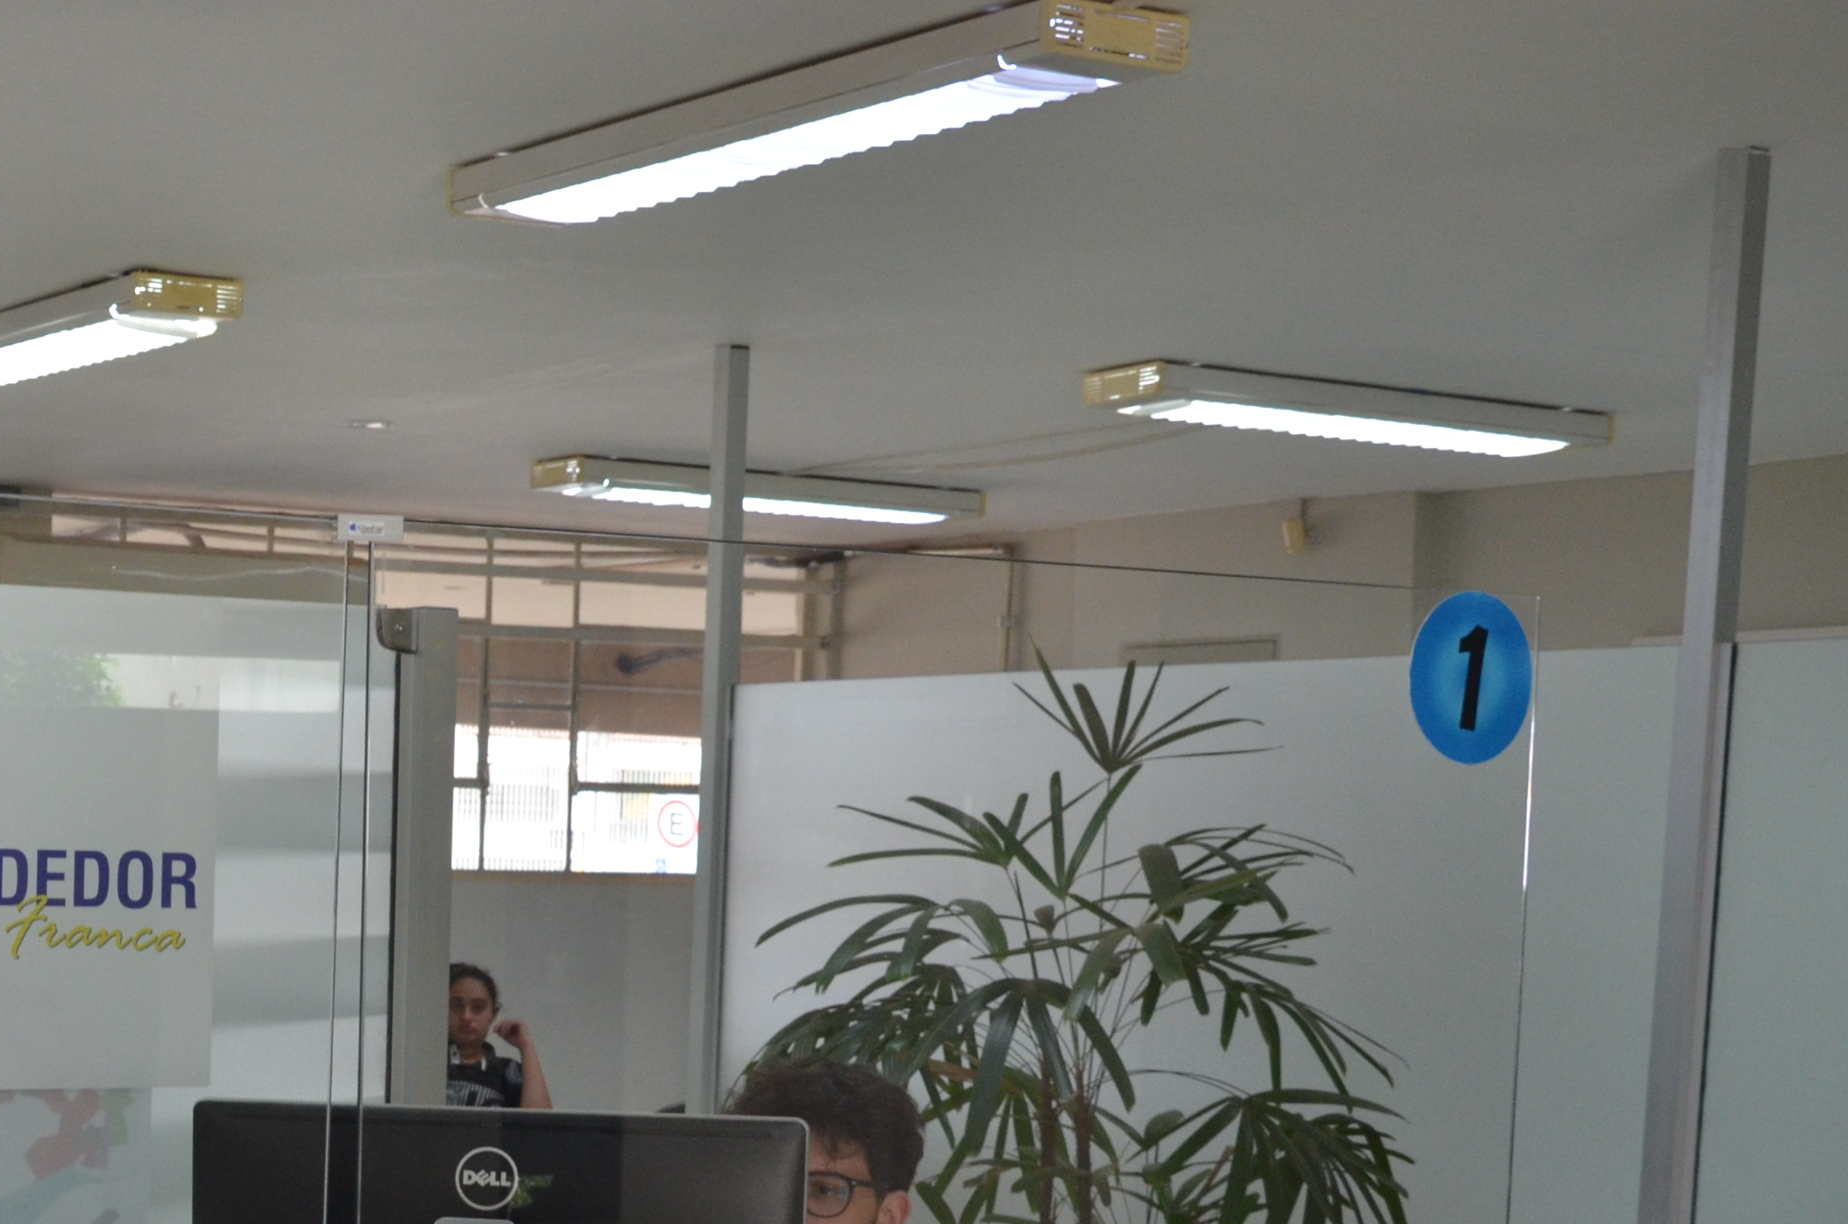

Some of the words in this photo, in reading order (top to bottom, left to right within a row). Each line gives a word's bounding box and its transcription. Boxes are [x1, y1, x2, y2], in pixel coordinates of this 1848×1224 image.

[1459, 625, 1489, 731] 1
[670, 812, 682, 836] E
[5, 894, 186, 959] Franca
[463, 1169, 511, 1187] DELL
